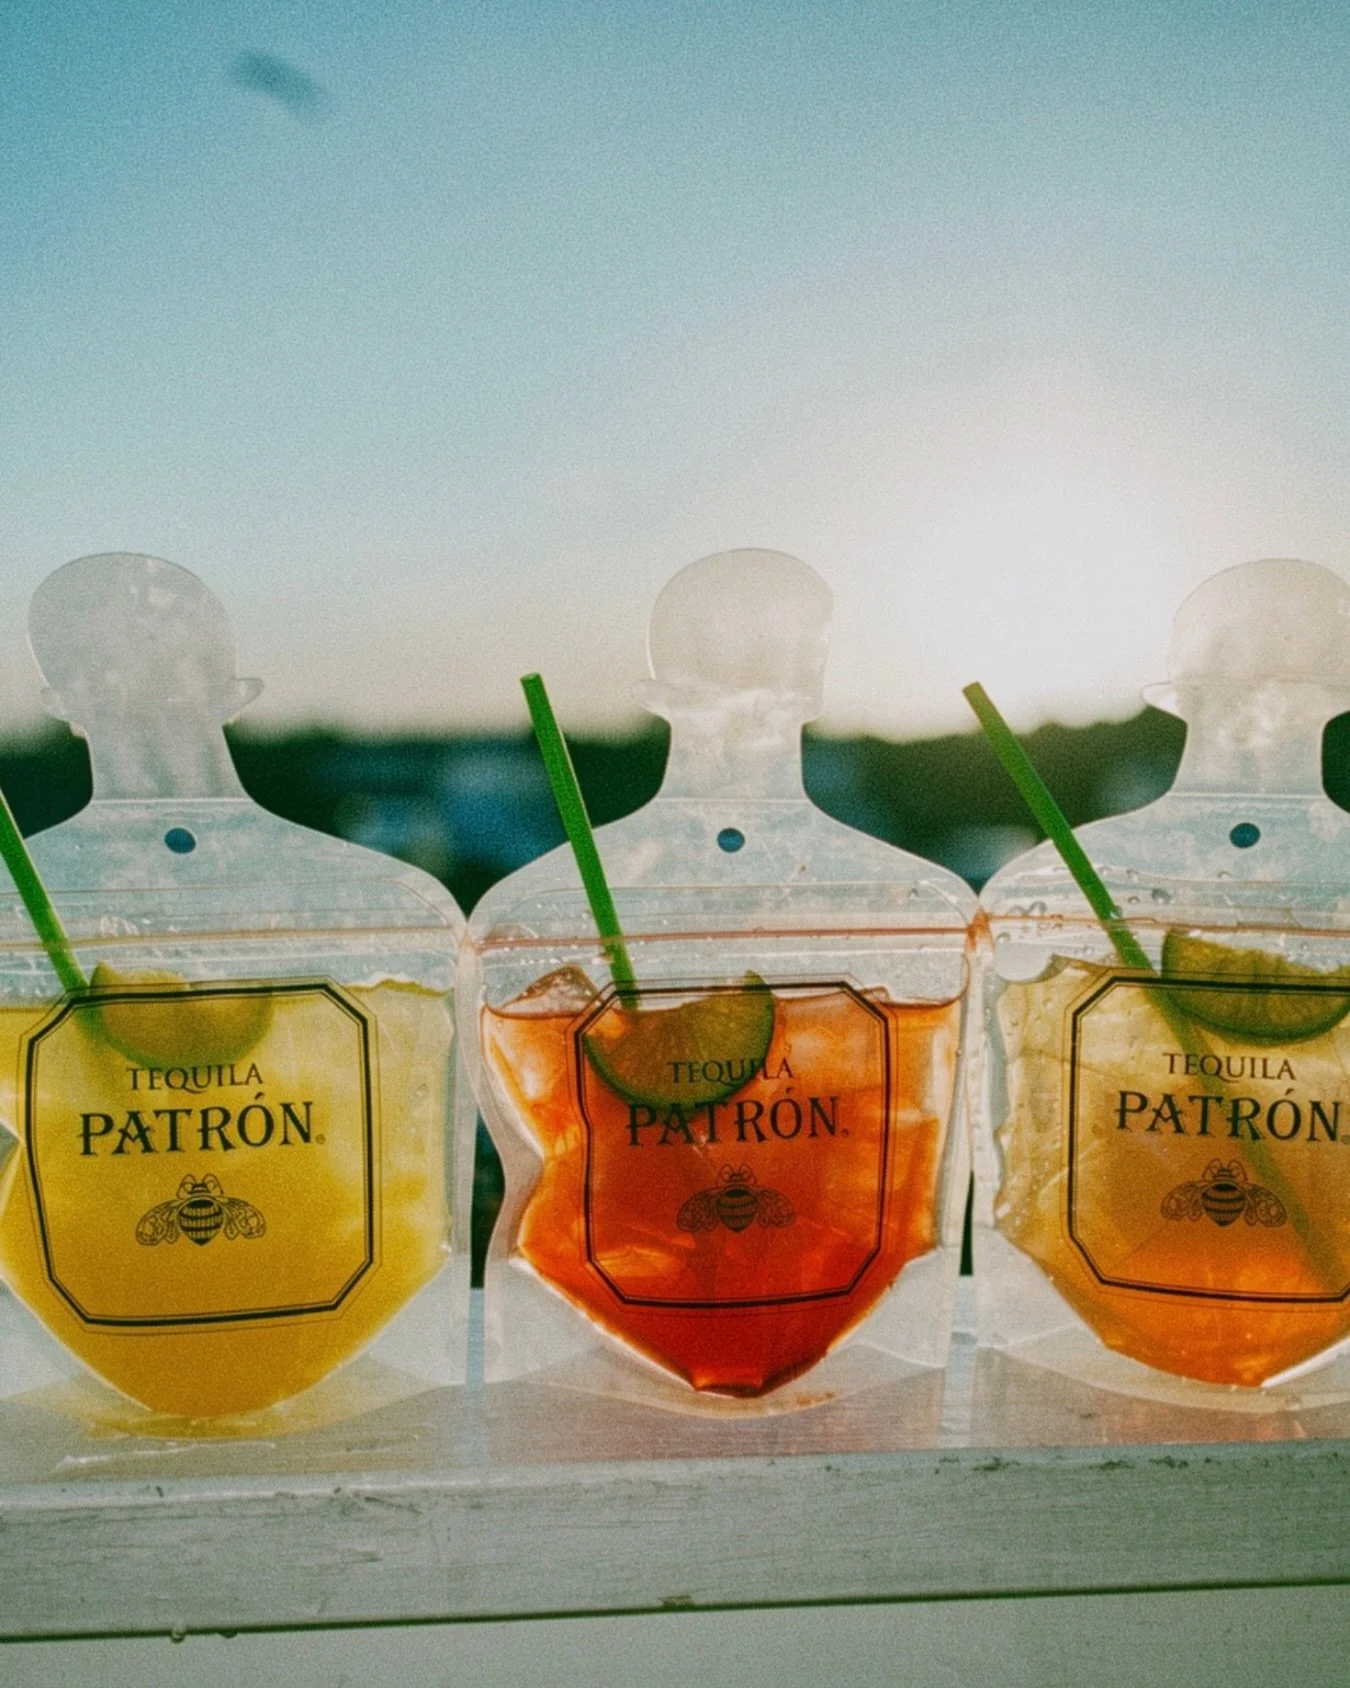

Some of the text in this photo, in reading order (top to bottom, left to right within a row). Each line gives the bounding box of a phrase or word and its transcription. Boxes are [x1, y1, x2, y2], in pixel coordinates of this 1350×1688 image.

[127, 1063, 264, 1094] TEQUILA
[669, 1057, 794, 1088] TEQUILA
[1162, 1052, 1296, 1083] TEQUILA
[78, 1092, 313, 1156] PATRÓN
[625, 1087, 839, 1146] PATRÓN
[1114, 1088, 1343, 1142] PATRÓN
